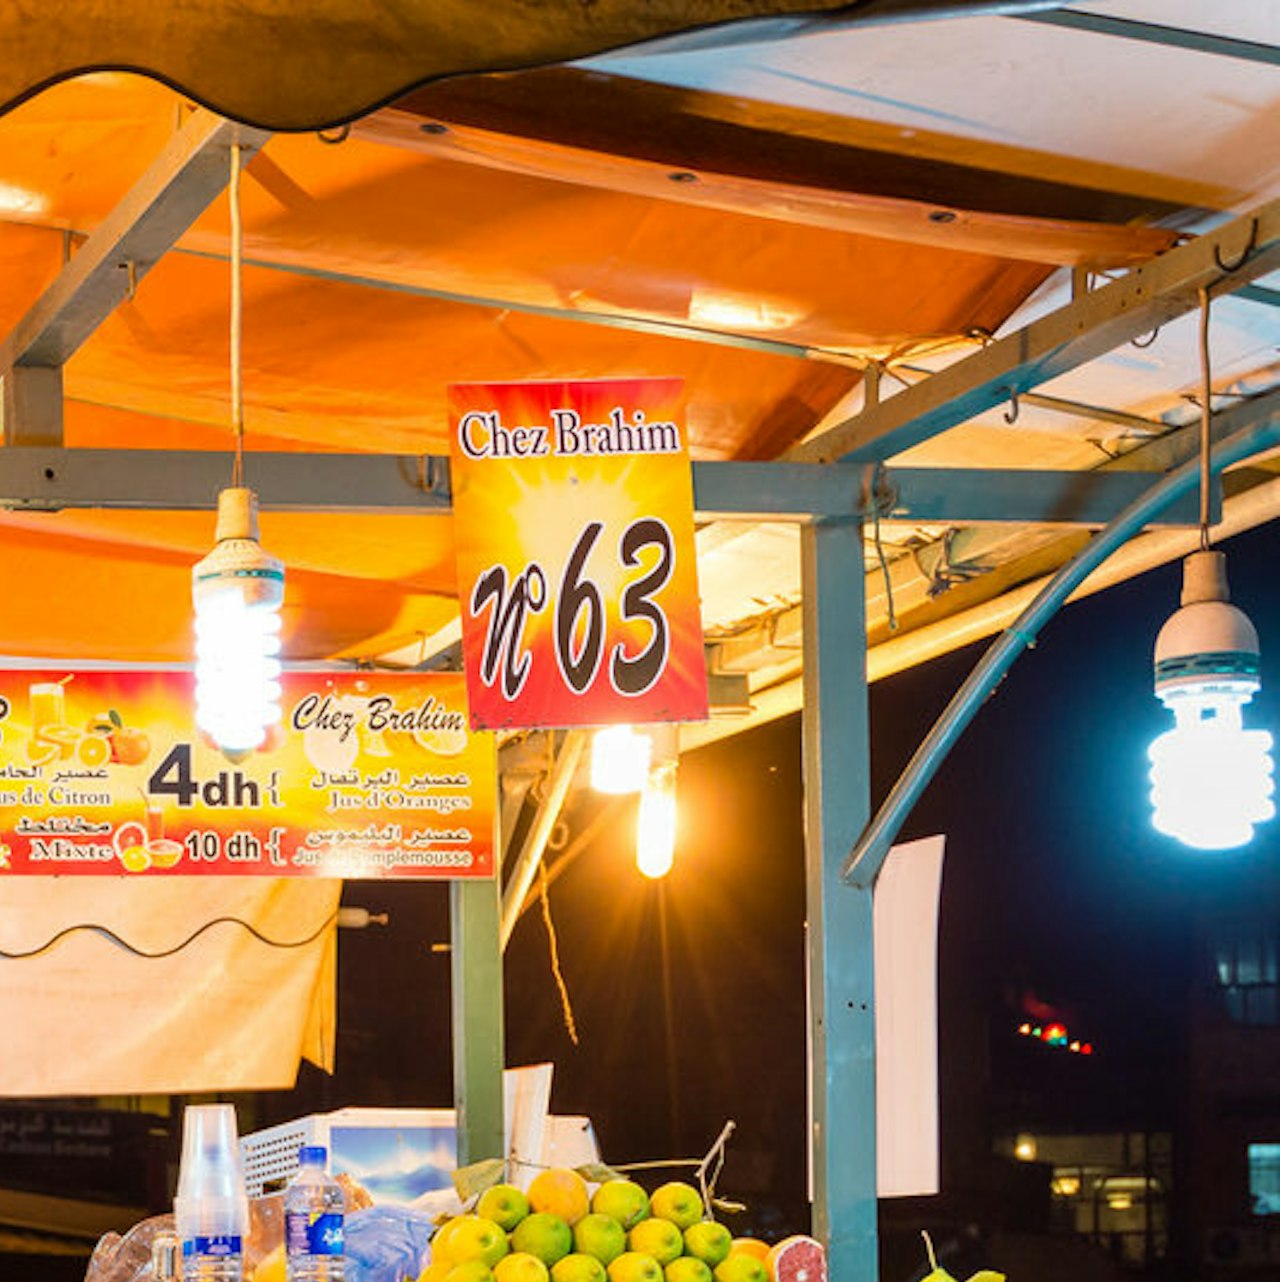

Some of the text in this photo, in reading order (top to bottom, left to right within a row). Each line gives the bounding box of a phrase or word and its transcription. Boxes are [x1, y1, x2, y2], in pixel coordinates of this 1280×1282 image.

[461, 408, 679, 456] Chez Brahim
[557, 519, 674, 694] 63
[293, 696, 464, 742] Chez Brahim
[21, 786, 42, 804] de
[48, 786, 110, 805] Citron
[329, 792, 362, 810] Jus
[34, 841, 112, 859] Mixte
[187, 834, 259, 858] 10 dh
[351, 849, 472, 866] mplemousse
